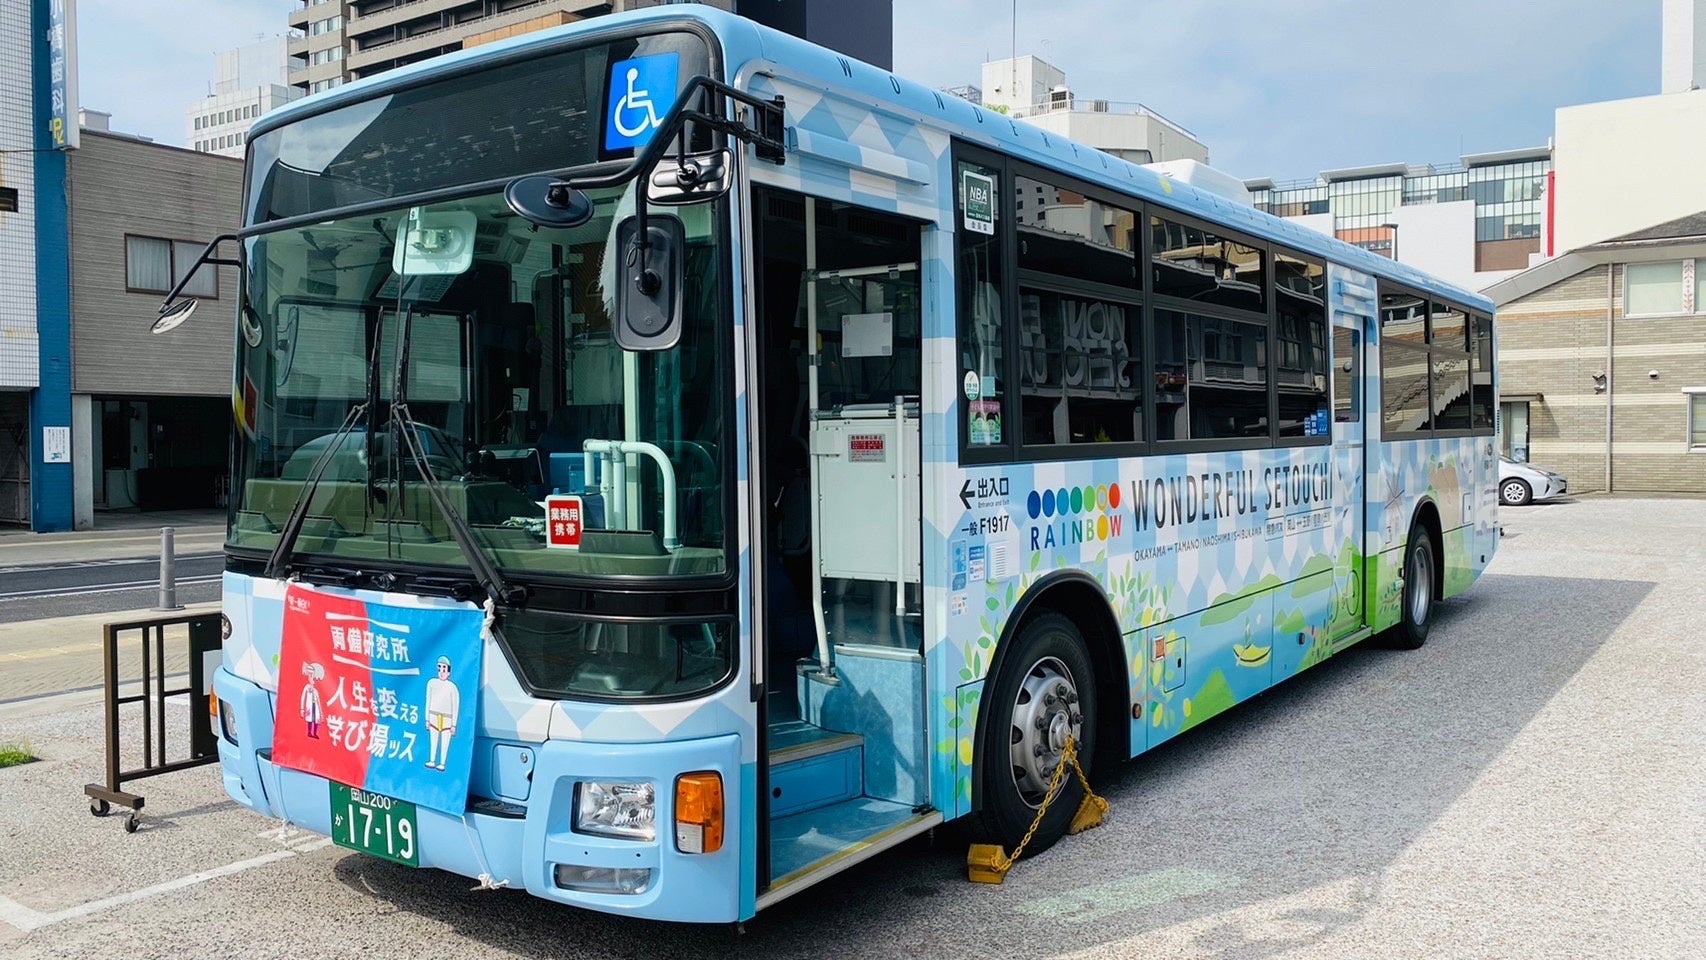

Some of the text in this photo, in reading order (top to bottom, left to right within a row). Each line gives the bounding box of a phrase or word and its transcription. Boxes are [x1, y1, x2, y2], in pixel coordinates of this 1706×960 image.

[970, 186, 988, 202] NBA
[978, 477, 1009, 498] 出入口
[1132, 462, 1333, 532] WONDERFUL SETOUCHI
[551, 508, 578, 521] 業務用
[554, 522, 576, 536] 携帯
[962, 515, 1009, 536] 一般 F1917
[1030, 514, 1122, 551] RAINBOW
[1134, 544, 1166, 561] OKAYAMA
[1174, 538, 1200, 553] TAMANO
[330, 625, 411, 663] 両備研究所
[326, 676, 419, 725] 人生を変える
[326, 714, 417, 762] 学び場ッス
[348, 803, 413, 859] 17-19
